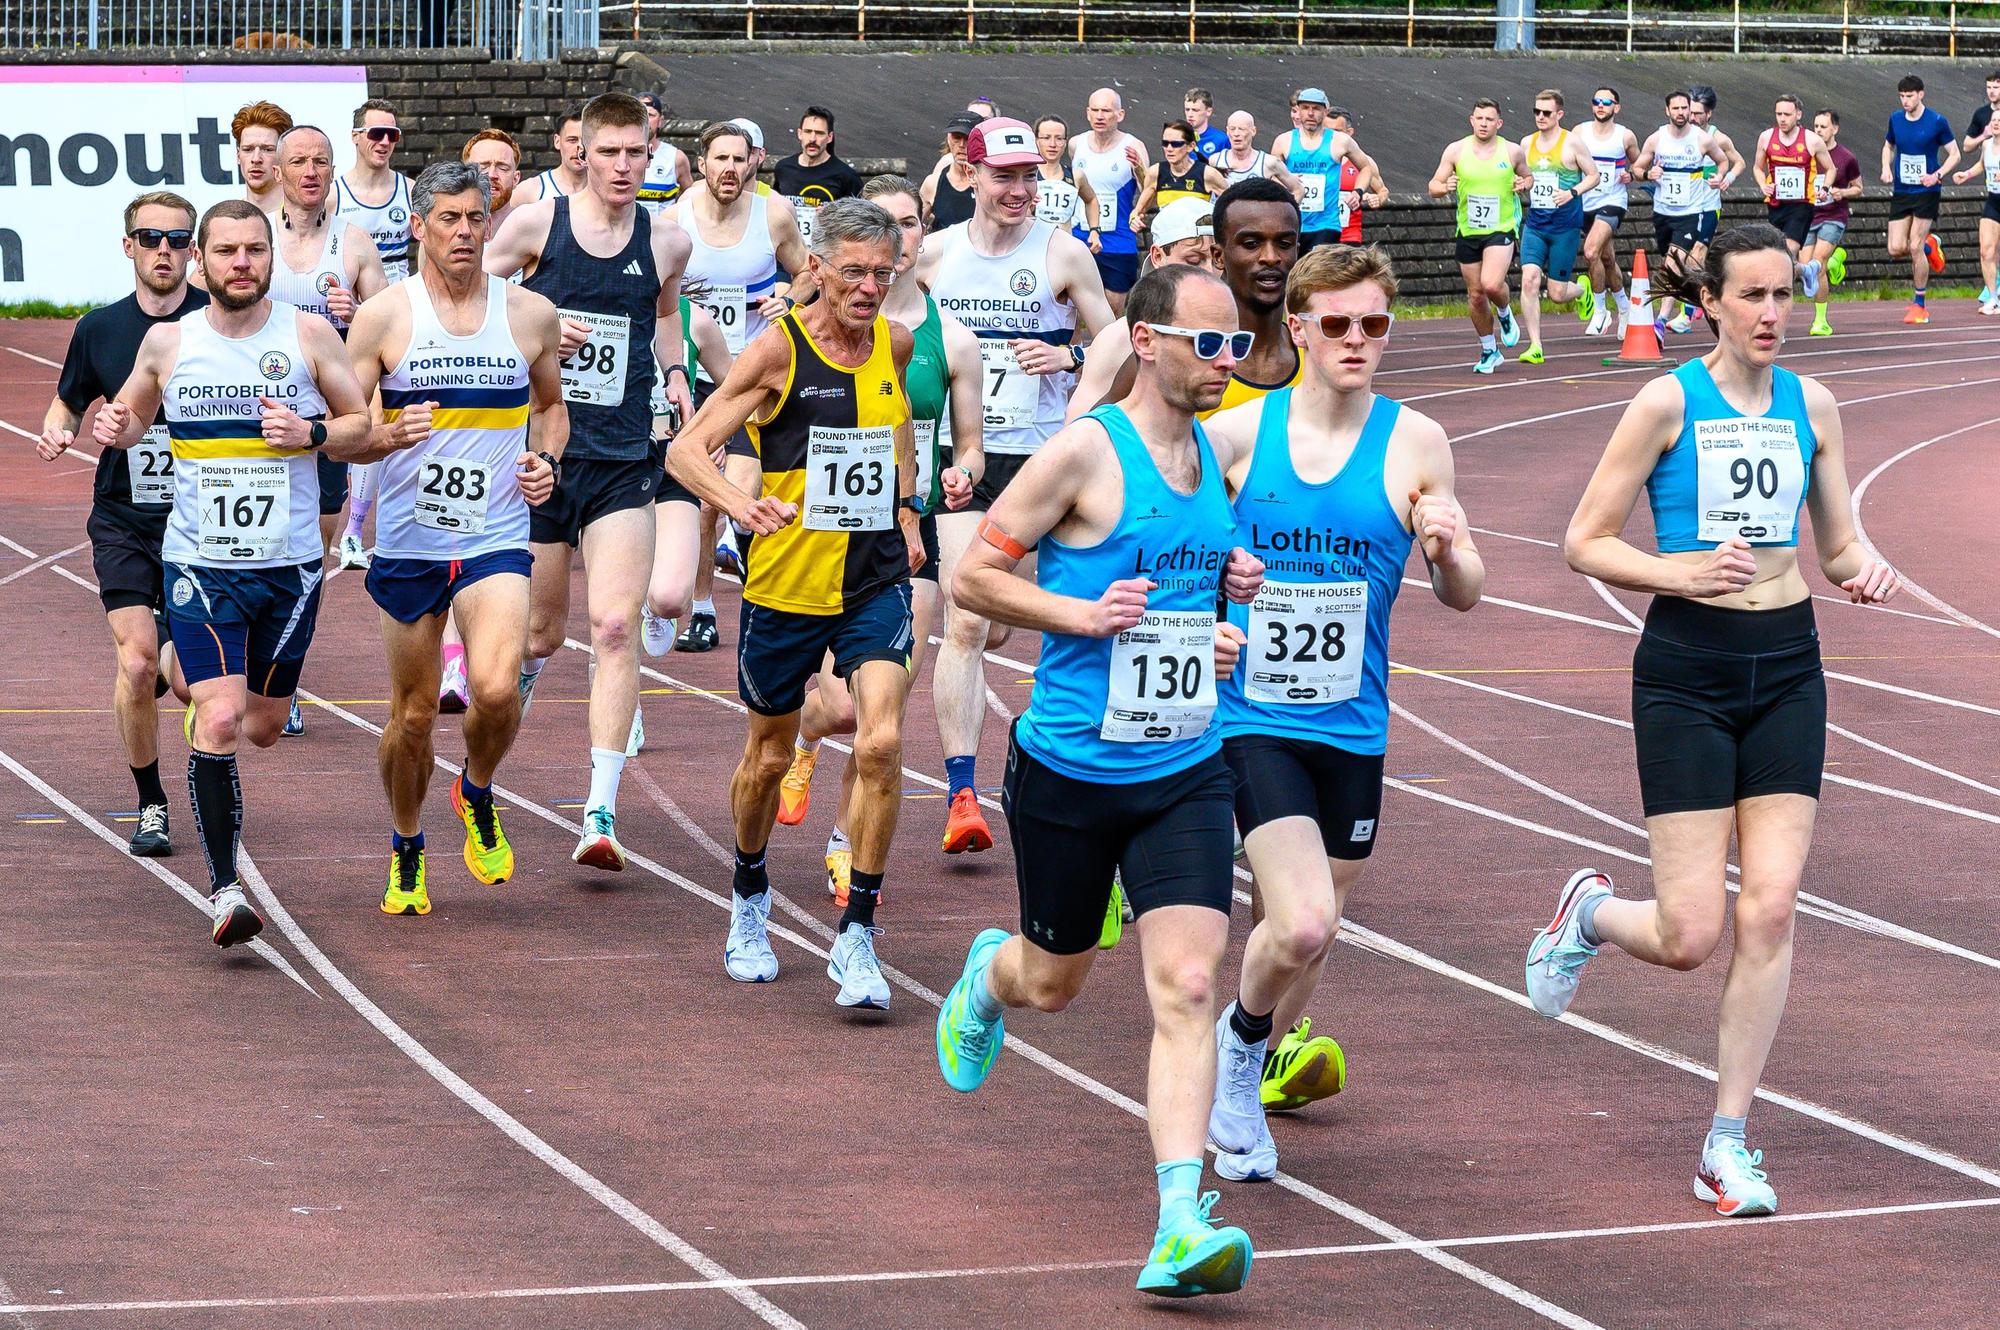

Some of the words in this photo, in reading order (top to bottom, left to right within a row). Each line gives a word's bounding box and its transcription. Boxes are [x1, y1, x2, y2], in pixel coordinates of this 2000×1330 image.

[0, 113, 245, 187] mout
[1904, 163, 1922, 175] 358
[1669, 183, 1681, 194] 13
[1780, 177, 1799, 188] 461
[1533, 185, 1553, 197] 429
[1044, 193, 1070, 208] 115
[1099, 204, 1110, 217] 3
[1475, 205, 1491, 218] 37
[940, 298, 1041, 313] PORTOBELLO
[556, 312, 582, 323] OUND
[583, 315, 598, 325] THE
[599, 318, 627, 328] HOUSES
[955, 317, 1002, 328] NNING
[1005, 317, 1039, 329] CLUB
[990, 342, 1005, 350] THE
[409, 356, 516, 371] PORTOBELLO
[410, 374, 474, 388] RUNNING
[478, 374, 515, 386] CLUB
[178, 384, 298, 399] PORTOBELLO
[180, 403, 252, 418] RUNNING
[257, 403, 298, 417] CB
[913, 423, 931, 431] USES
[1700, 423, 1739, 434] ROUND
[1741, 422, 1760, 432] THE
[1761, 423, 1792, 434] HOUSES
[812, 430, 846, 441] ROUND
[847, 432, 863, 441] THE
[864, 430, 891, 440] HOUSES
[201, 466, 231, 475] ROUND
[233, 467, 249, 475] THE
[251, 466, 285, 474] HOUSES
[423, 463, 485, 501] 283
[824, 461, 884, 497] 163
[1730, 457, 1779, 500] 90
[213, 495, 275, 527] 167
[1252, 523, 1370, 560] Lothian
[1330, 559, 1367, 577] Club
[1148, 575, 1195, 593] nning
[1199, 575, 1218, 591] Clu
[1260, 585, 1293, 597] OUND
[1294, 589, 1316, 598] THE
[1318, 586, 1362, 597] HOUSES
[1325, 603, 1361, 611] SCOTTISH
[1139, 616, 1160, 627] UND
[1162, 617, 1181, 627] THE
[1183, 617, 1213, 628] HOUSES
[1264, 621, 1346, 663] 328
[1132, 654, 1201, 700] 130
